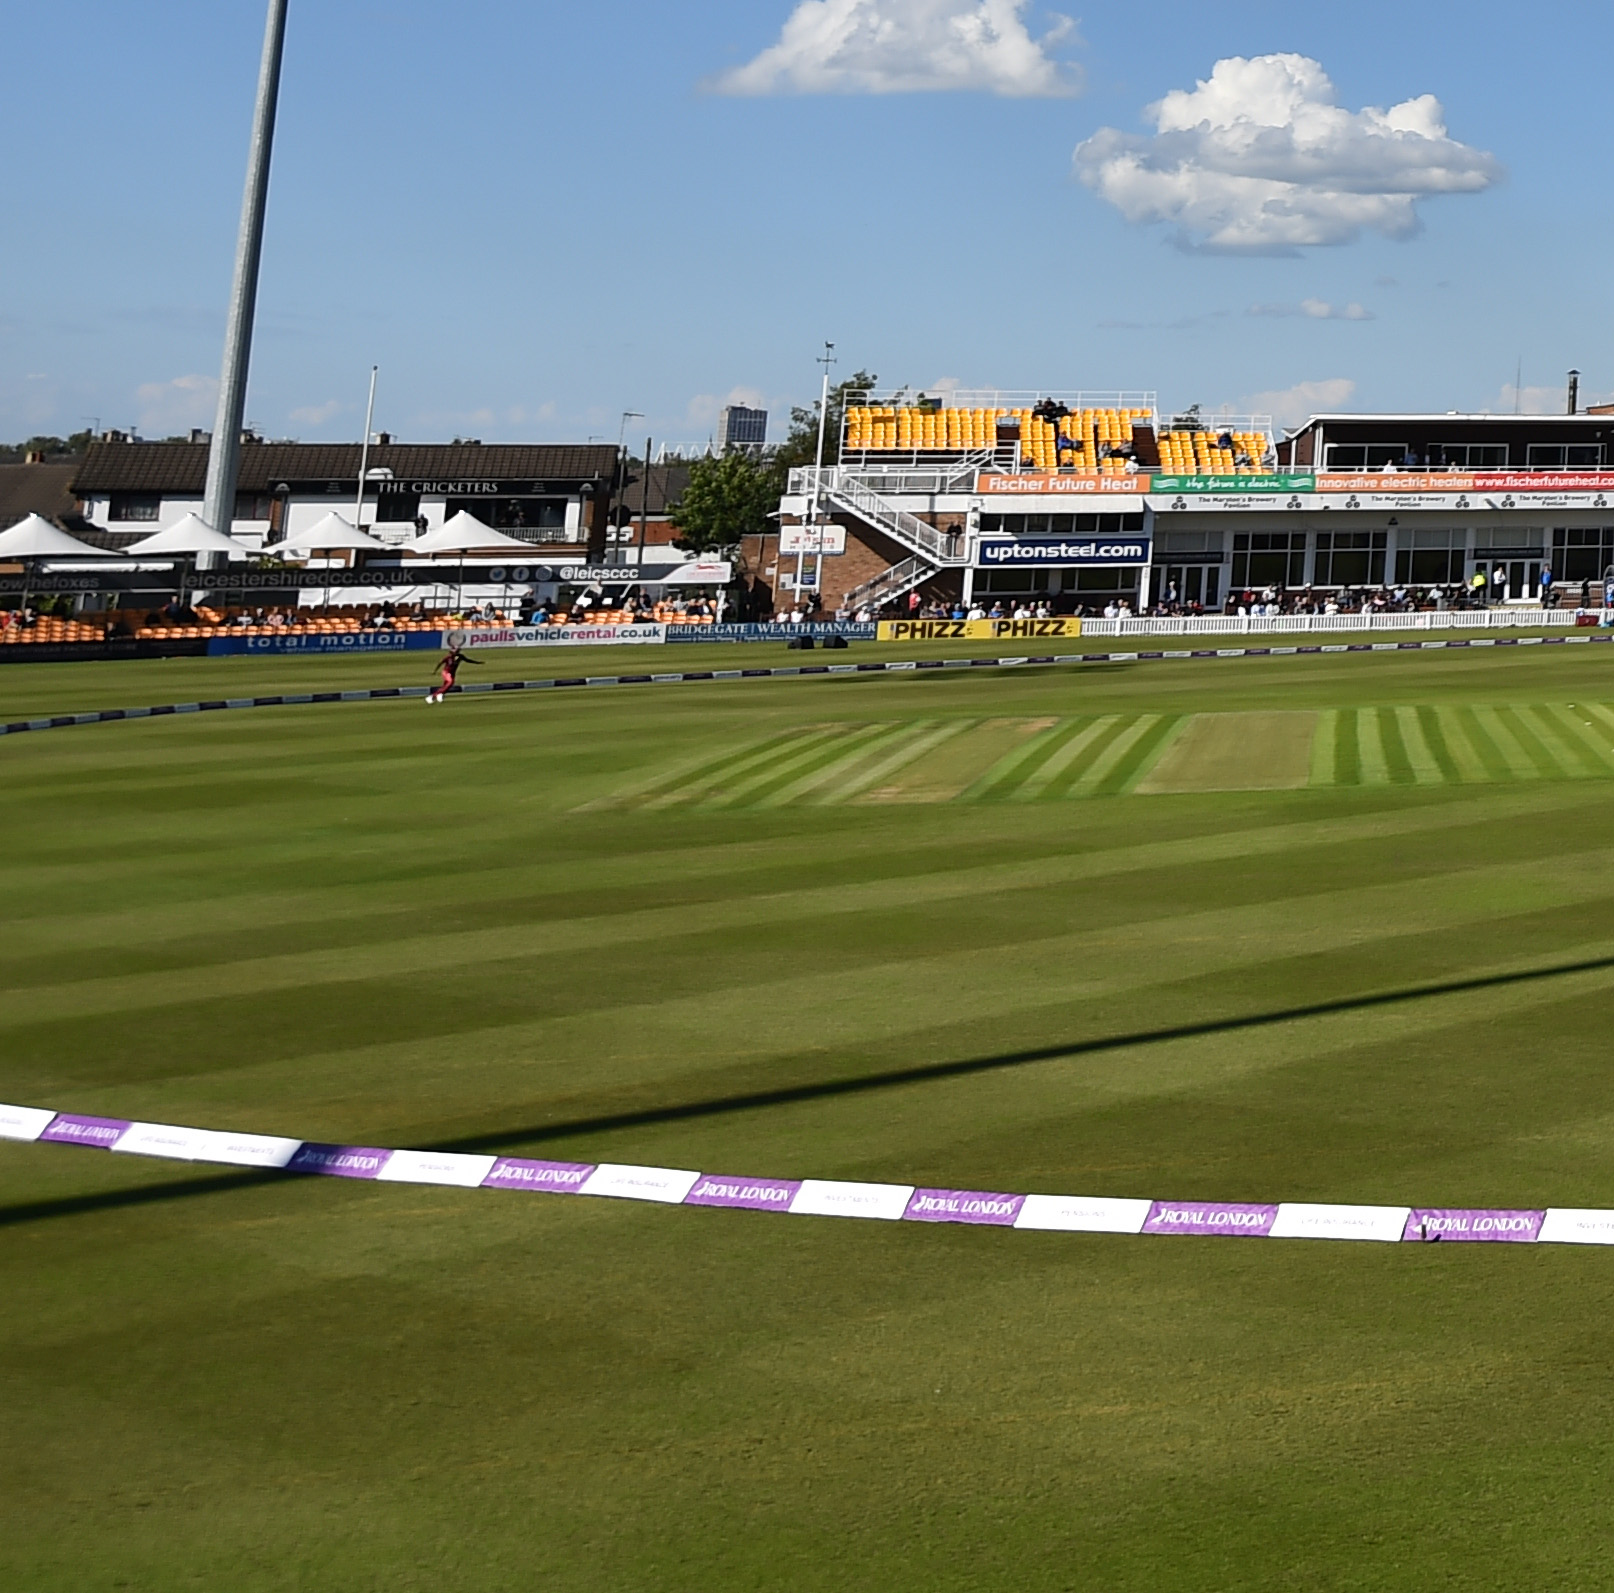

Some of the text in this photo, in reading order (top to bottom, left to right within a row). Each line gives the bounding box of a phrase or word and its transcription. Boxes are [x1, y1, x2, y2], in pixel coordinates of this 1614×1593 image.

[378, 482, 499, 494] THE CRICKETERS
[988, 476, 1138, 490] Fischer Future Heat
[1316, 475, 1474, 488] Innovative electric heaters
[986, 542, 1143, 562] uptonsteel.com
[184, 568, 415, 589] eicestershireccc.co.uk
[559, 565, 639, 582] @leicsccc
[470, 626, 661, 645] paullsvehiclerental.co.uk
[667, 621, 876, 635] BRIDGEGATE WEALTH MANAGER
[894, 621, 967, 638] PHIZZ
[996, 619, 1066, 637] PHIZZ
[247, 633, 406, 648] total motion
[500, 1165, 584, 1183] ROYAL LONDON
[705, 1182, 791, 1201] ROYAL LONDON
[924, 1194, 1015, 1217] ROYAL LONDON
[1165, 1209, 1266, 1226] ROYAL LONDON
[1428, 1216, 1533, 1232] ROYAL LONDON
